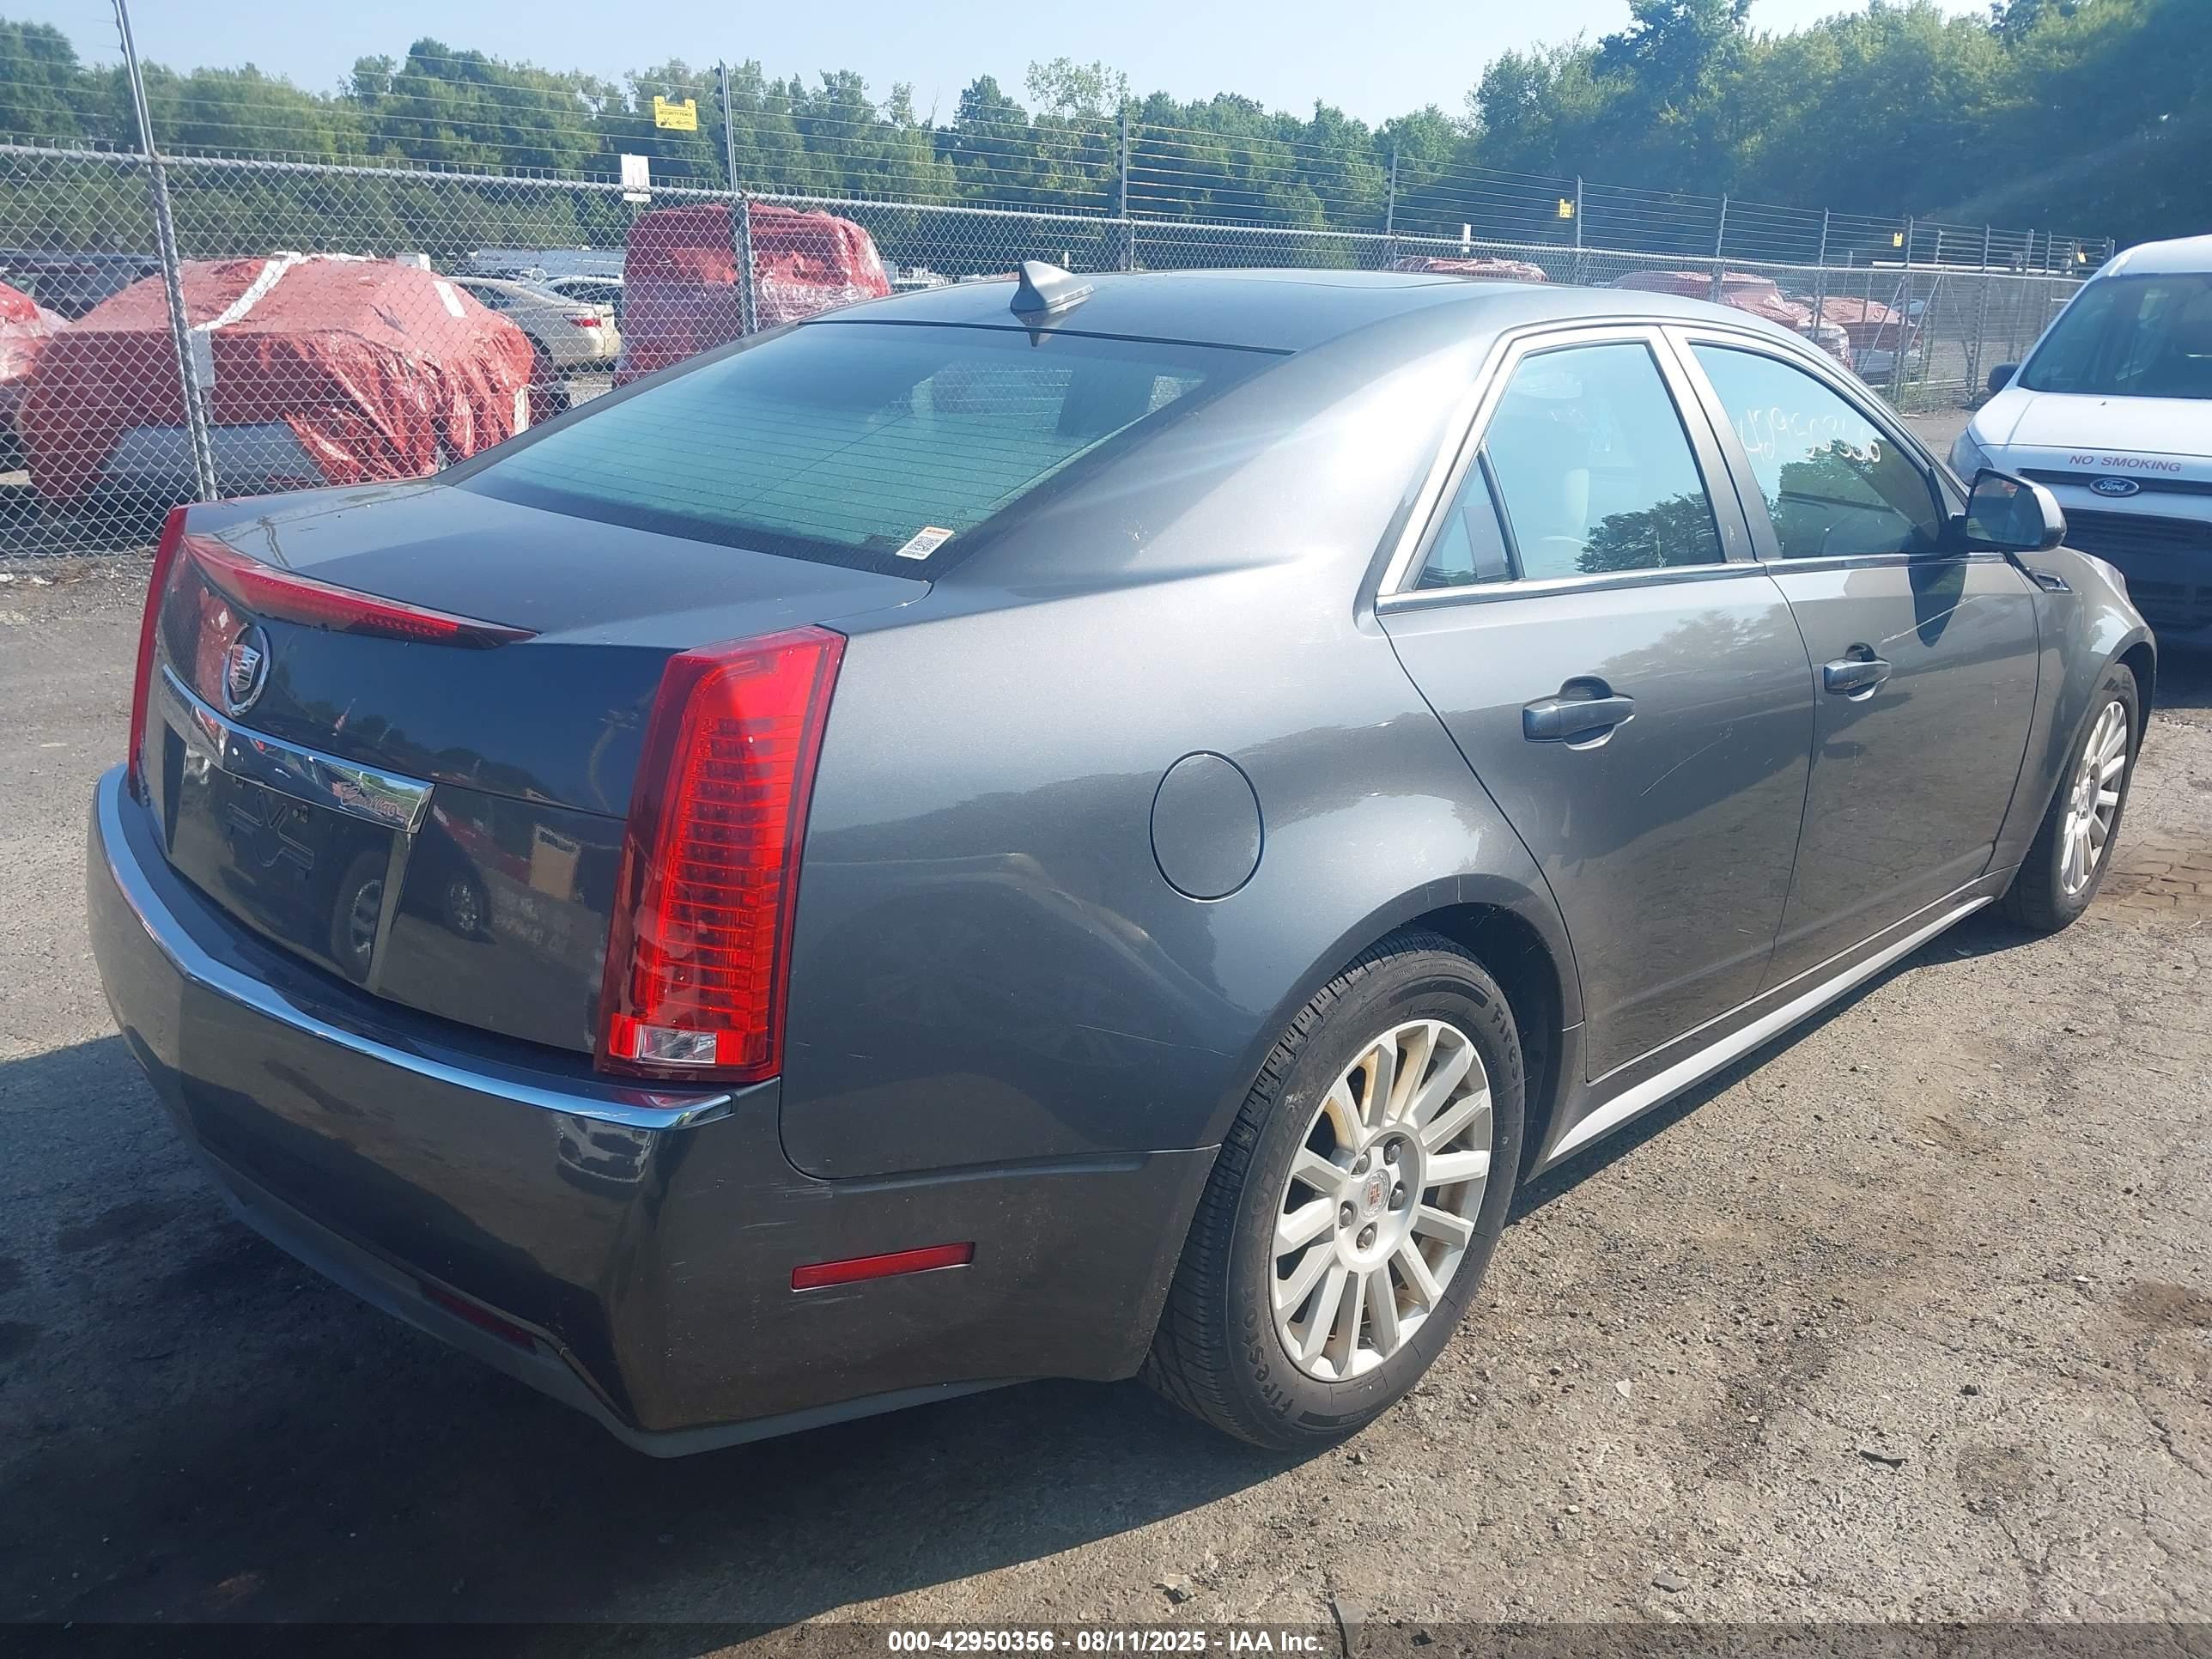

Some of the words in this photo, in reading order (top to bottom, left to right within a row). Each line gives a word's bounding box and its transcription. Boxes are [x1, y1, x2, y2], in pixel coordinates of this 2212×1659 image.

[2069, 454, 2095, 465] NO
[2100, 456, 2183, 472] SMOKING
[2100, 479, 2128, 492] Ford
